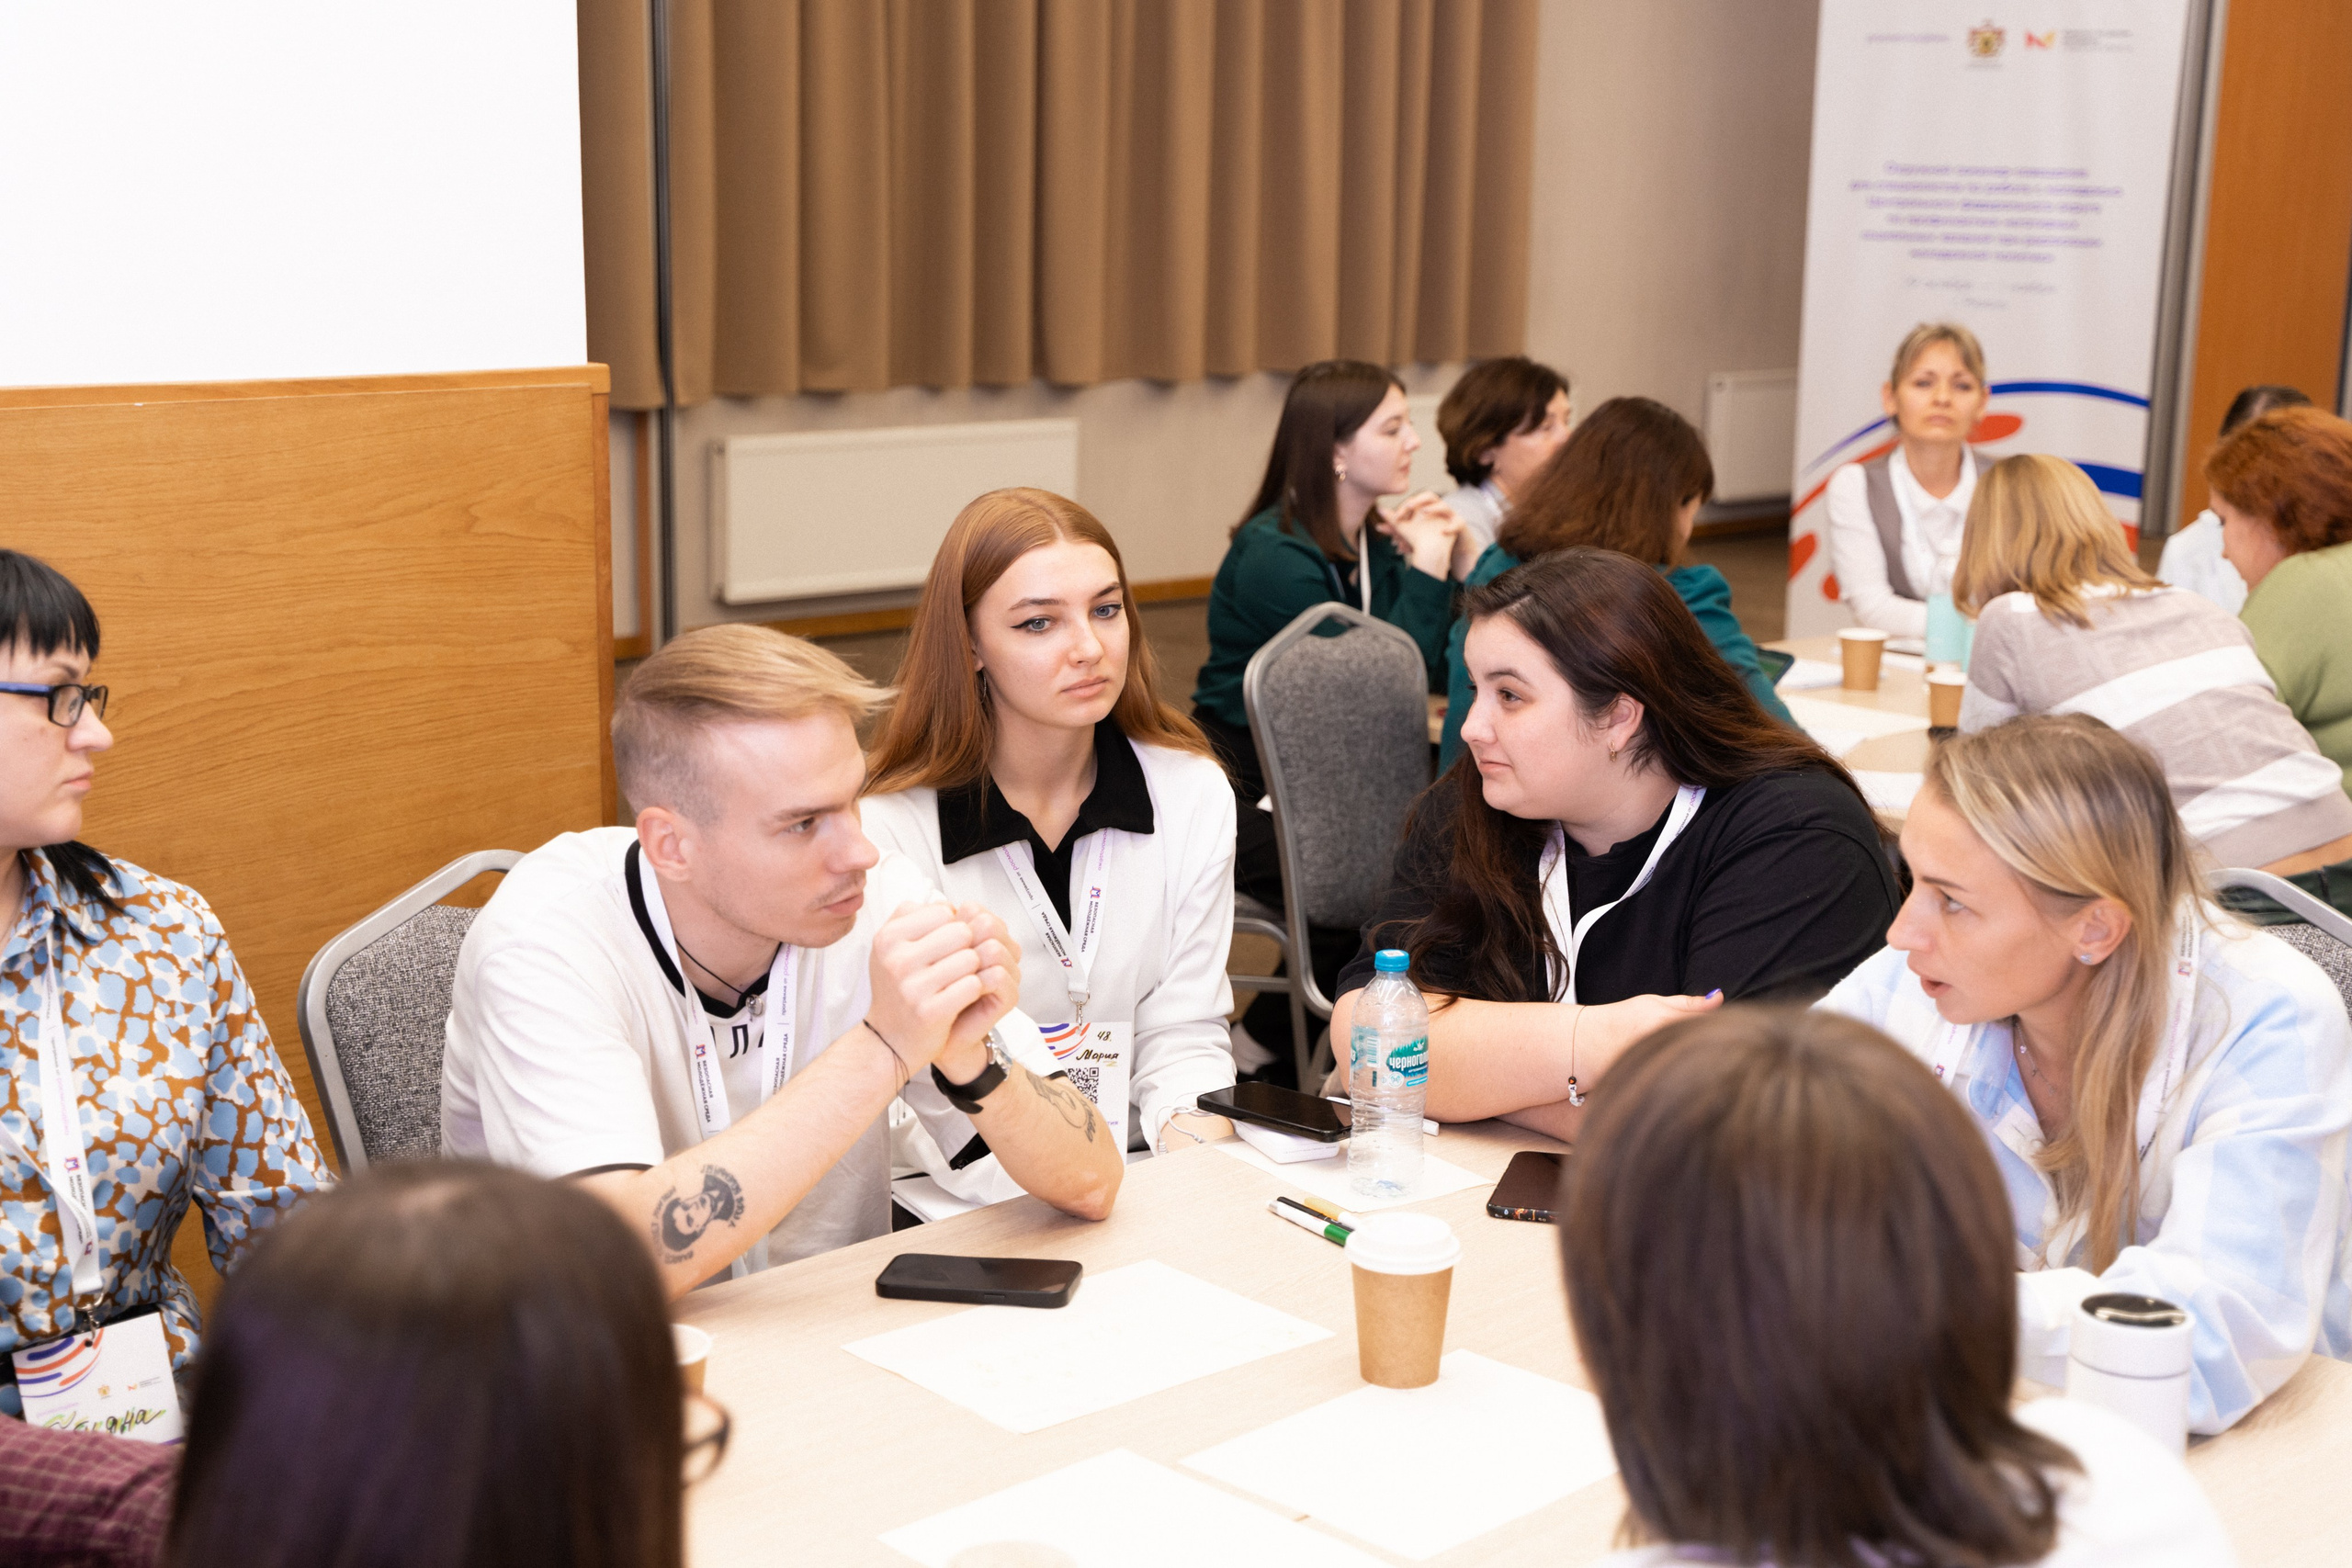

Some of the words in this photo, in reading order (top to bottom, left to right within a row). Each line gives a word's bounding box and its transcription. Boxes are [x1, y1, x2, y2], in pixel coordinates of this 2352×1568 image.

[1097, 827, 1108, 872] осмолодёжь
[1090, 901, 1099, 934] БЕЗОПАСНАЯ
[783, 943, 792, 976] росмол
[1076, 1049, 1119, 1062] Мария
[696, 1061, 708, 1104] МОЛОДЁЖНАЯ
[704, 1104, 712, 1123] СРЕДА
[702, 1060, 714, 1099] БЕЗОПАСНАЯ
